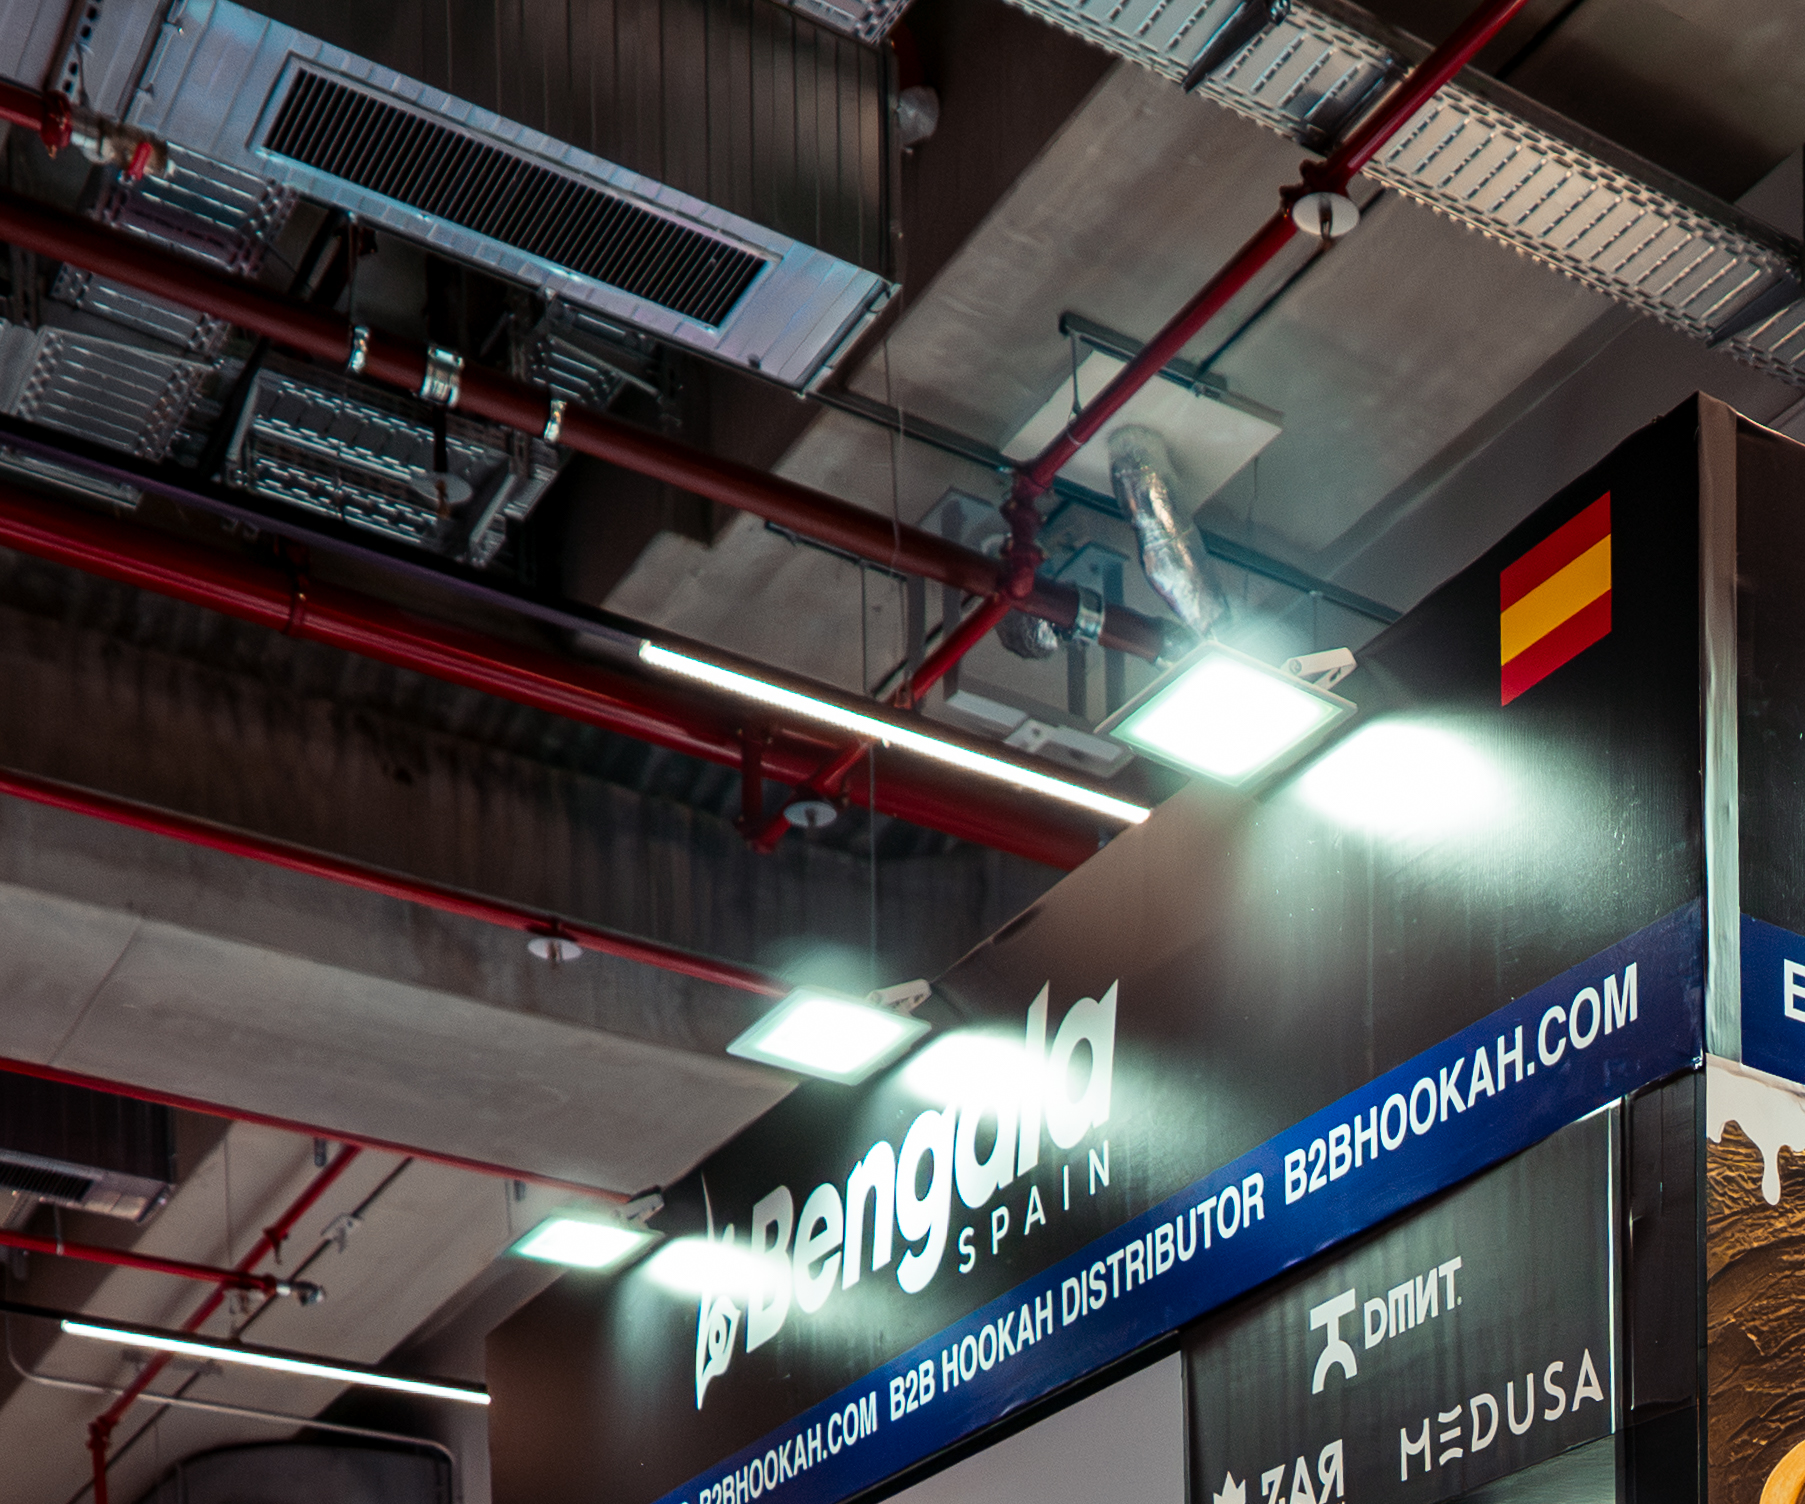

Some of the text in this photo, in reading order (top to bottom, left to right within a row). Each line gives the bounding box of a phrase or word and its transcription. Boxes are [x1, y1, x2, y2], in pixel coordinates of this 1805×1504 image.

[746, 979, 1118, 1354] Bengala
[889, 1360, 936, 1423] B2B
[941, 1298, 1054, 1393] HOOKAH
[1061, 1172, 1266, 1328] DISTRIBUTOR
[1283, 962, 1638, 1204] B2BHOOKAH.COM
[959, 1140, 1110, 1275] SPAIN
[1400, 1348, 1604, 1482] MEDUSA
